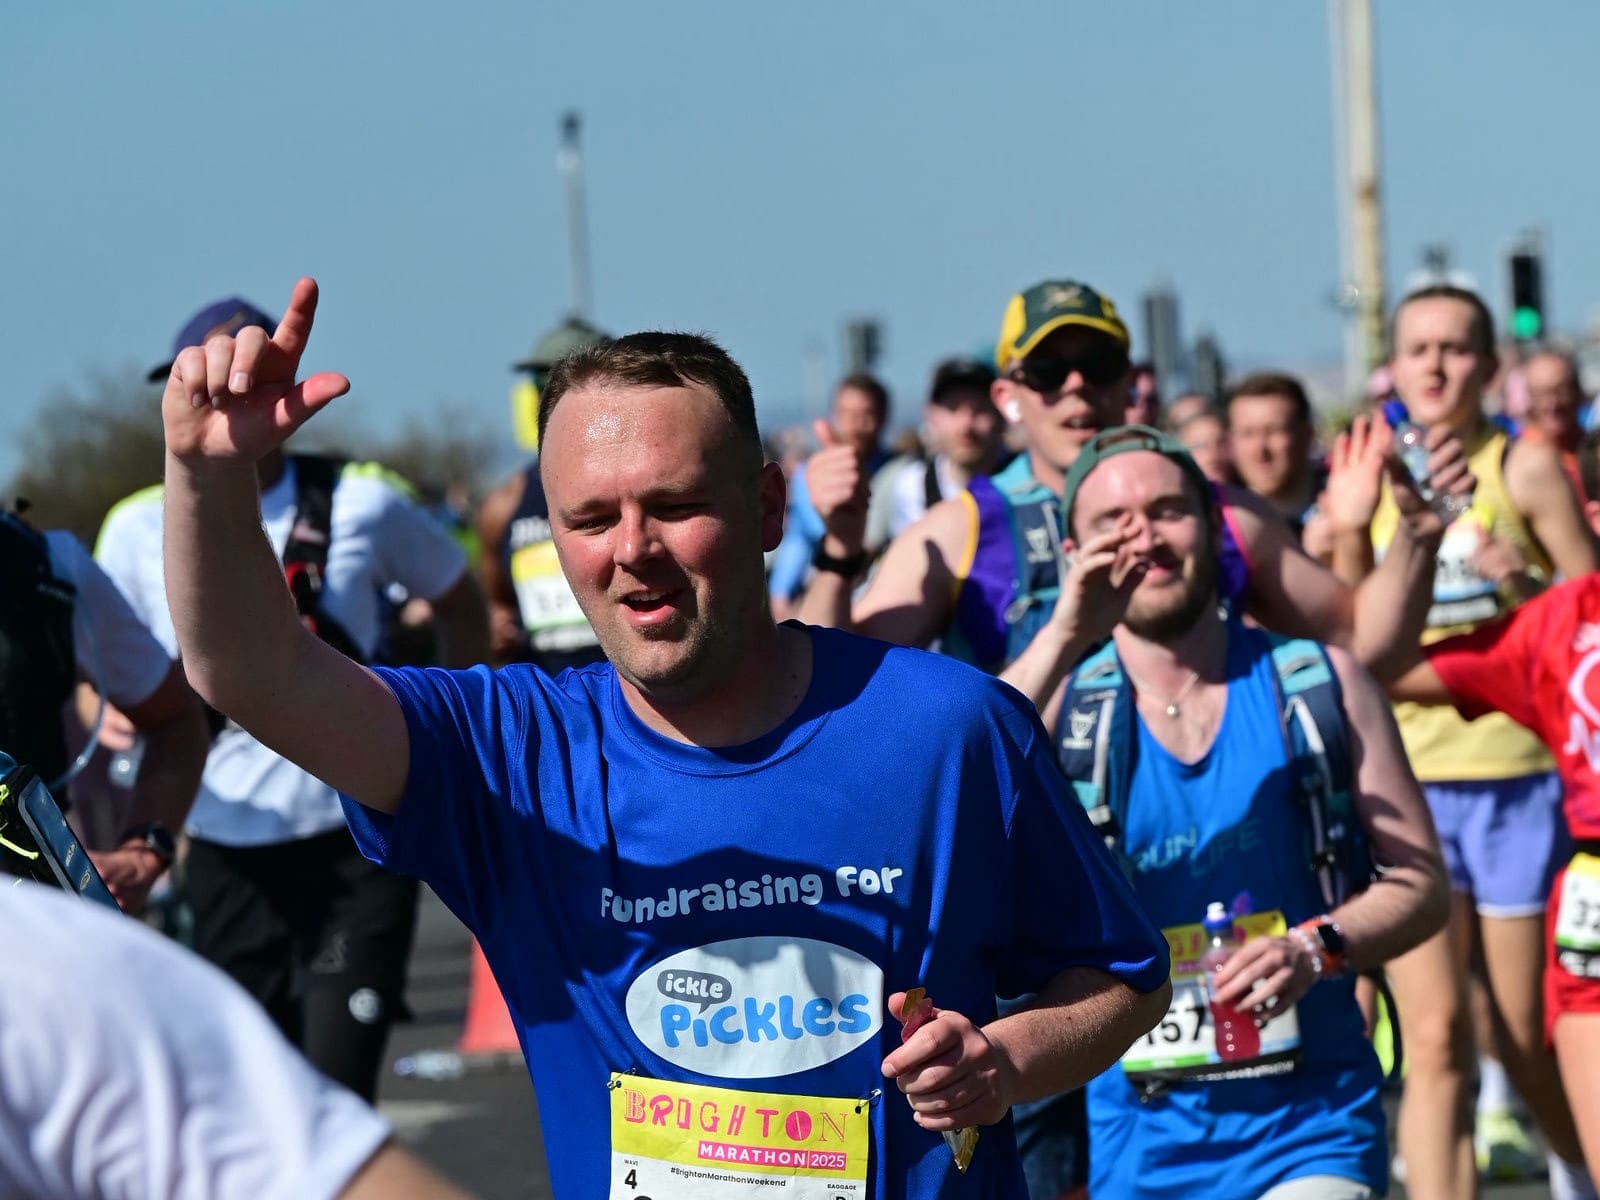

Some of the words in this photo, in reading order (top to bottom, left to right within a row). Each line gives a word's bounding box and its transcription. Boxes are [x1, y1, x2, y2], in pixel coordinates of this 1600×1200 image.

[601, 873, 823, 923] Fundraising
[666, 973, 724, 999] ickle
[624, 1088, 849, 1142] BRIGHTON
[700, 1144, 807, 1168] MARATHON
[810, 1153, 845, 1169] 2025
[624, 1169, 638, 1190] 4
[670, 1166, 787, 1188] #BrightonMarathonWeekend
[827, 1183, 857, 1191] BAGGAGE
